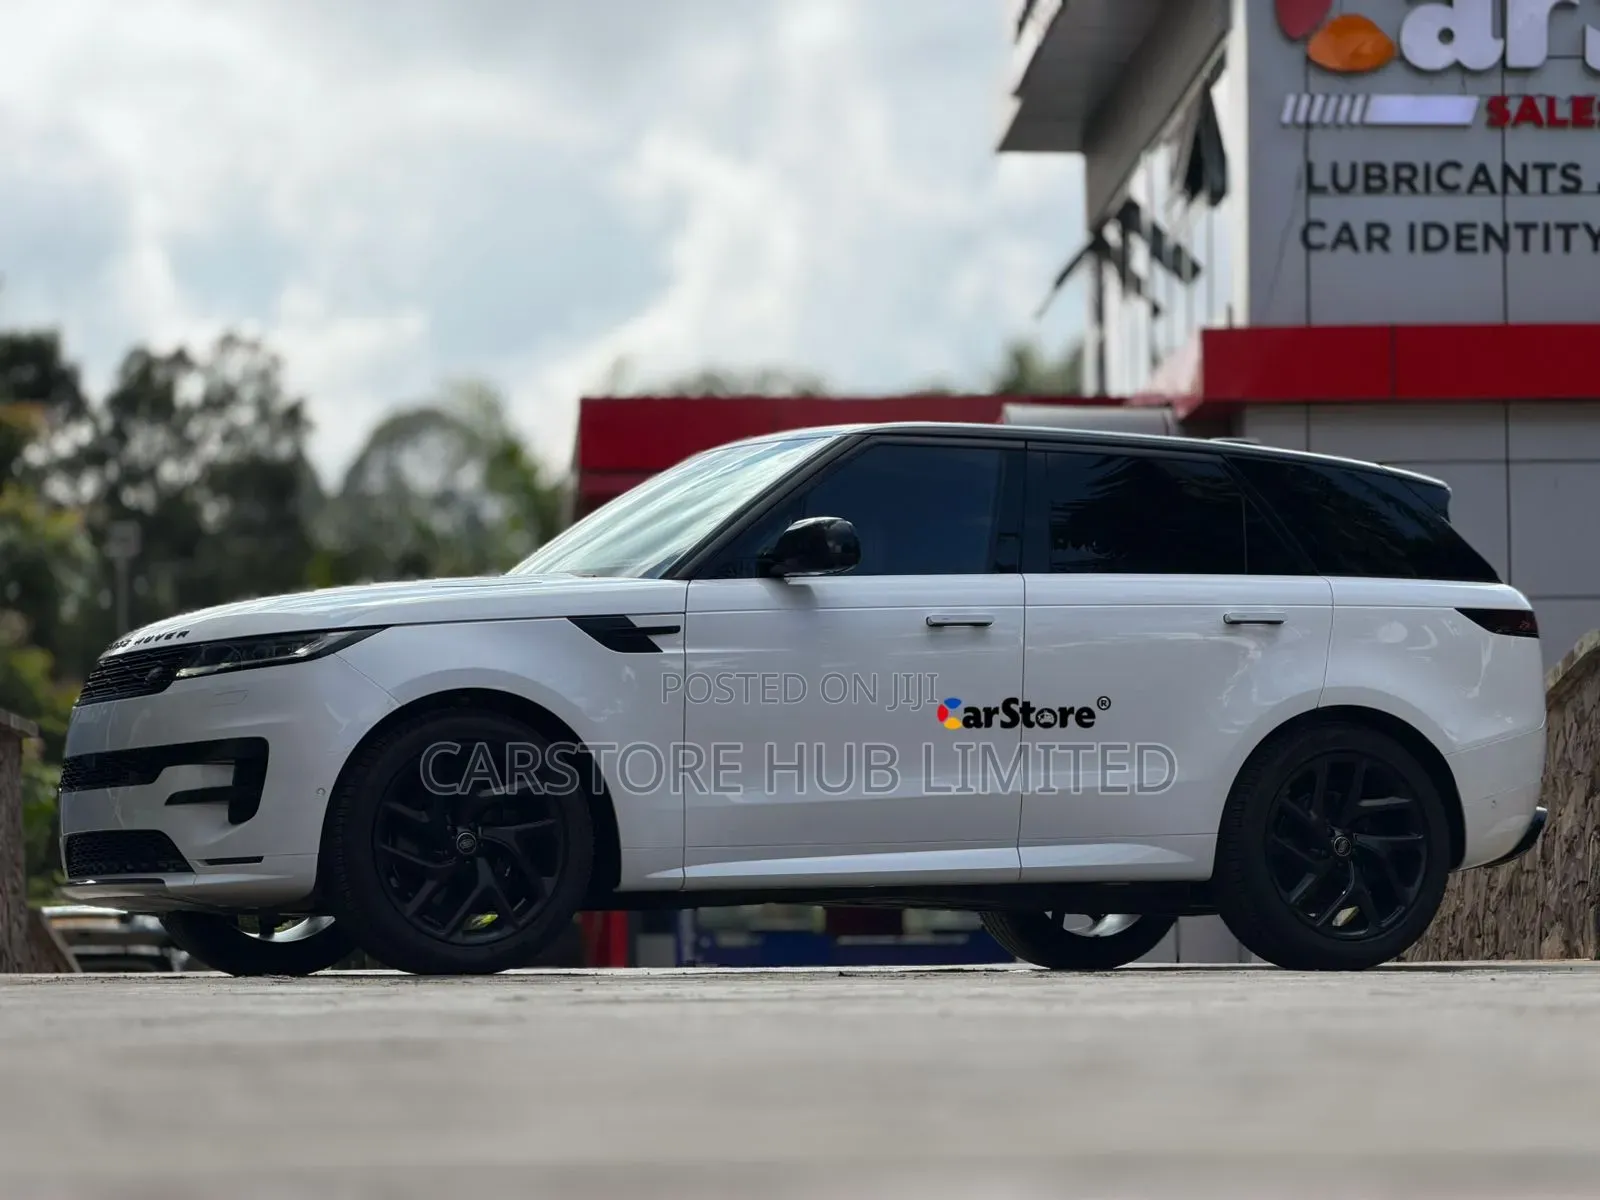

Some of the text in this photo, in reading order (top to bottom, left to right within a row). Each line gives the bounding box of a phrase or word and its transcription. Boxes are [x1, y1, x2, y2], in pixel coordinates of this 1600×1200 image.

[1486, 95, 1600, 129] SALE
[1306, 161, 1583, 195] LUBRICANTS
[1300, 219, 1391, 253] CAR
